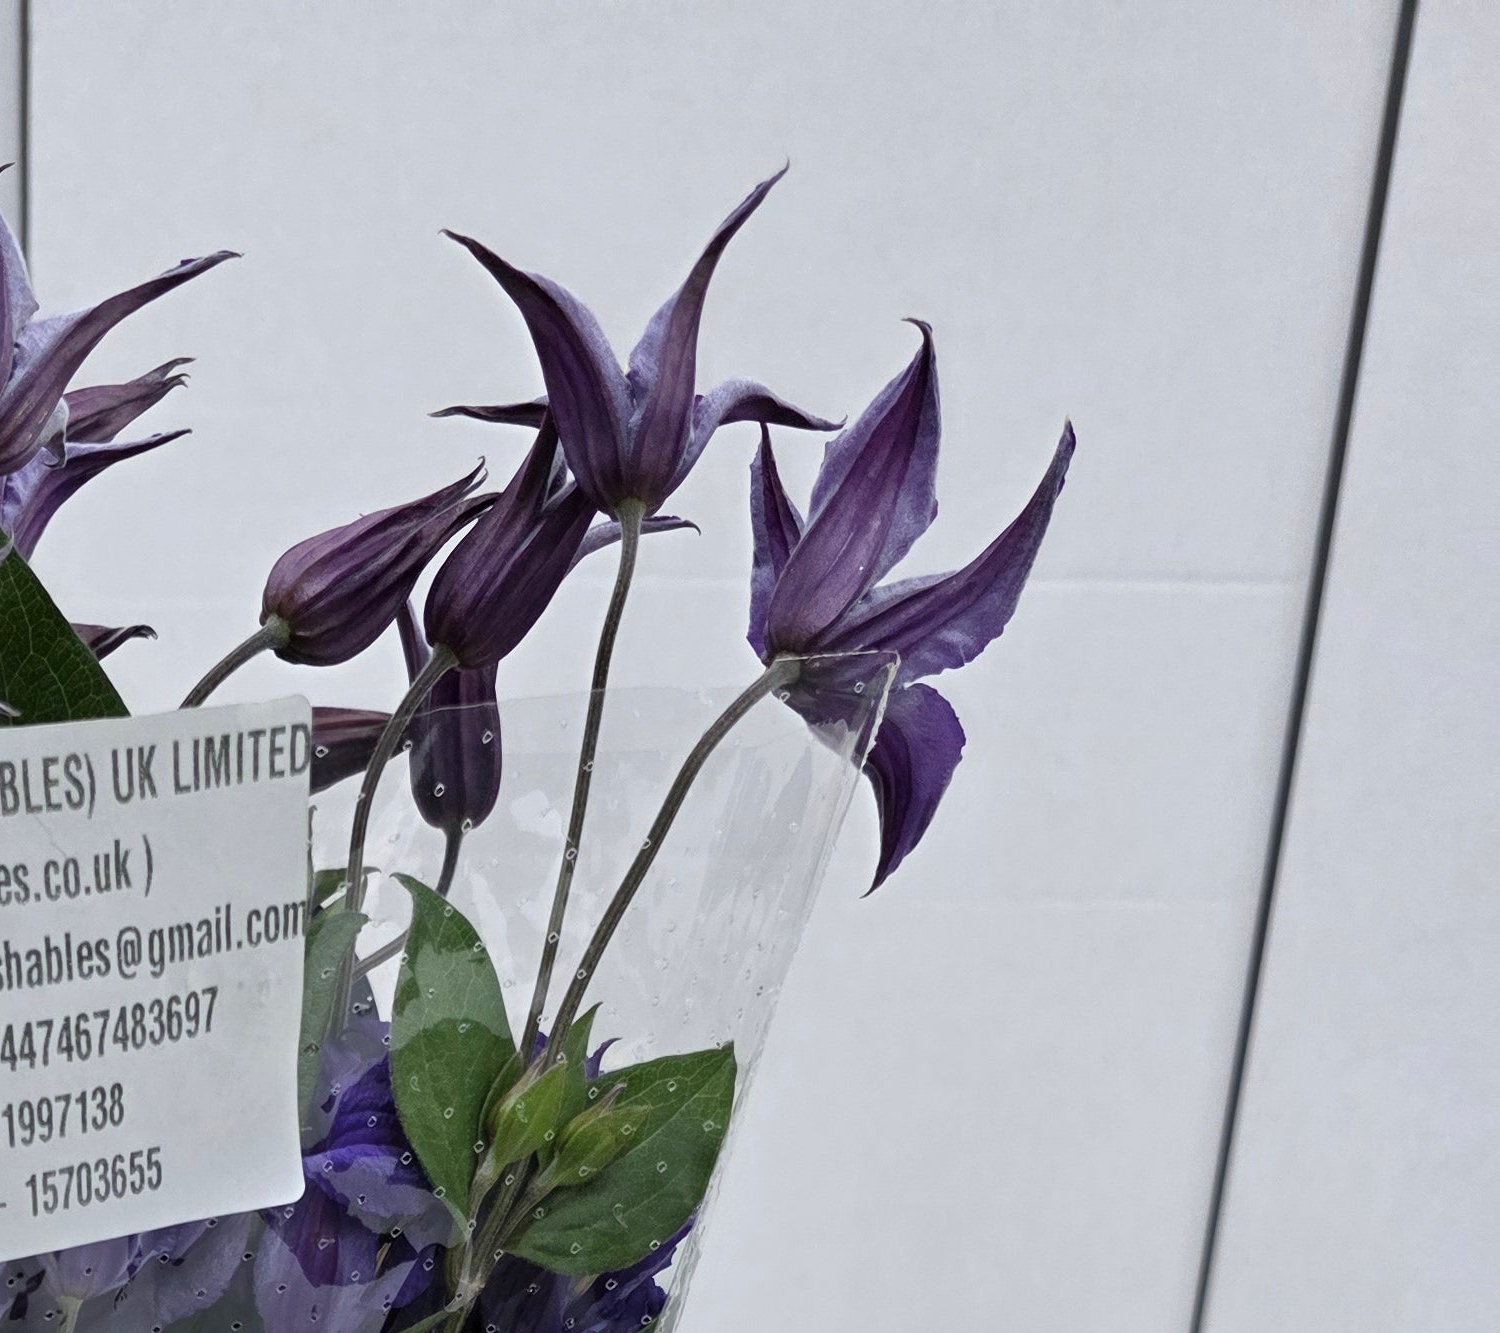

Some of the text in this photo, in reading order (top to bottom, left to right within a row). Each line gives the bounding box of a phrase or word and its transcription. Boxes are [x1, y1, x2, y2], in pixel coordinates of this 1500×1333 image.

[111, 744, 158, 804] UK
[172, 723, 311, 796] LIMITED
[24, 1145, 164, 1218] 15703655
